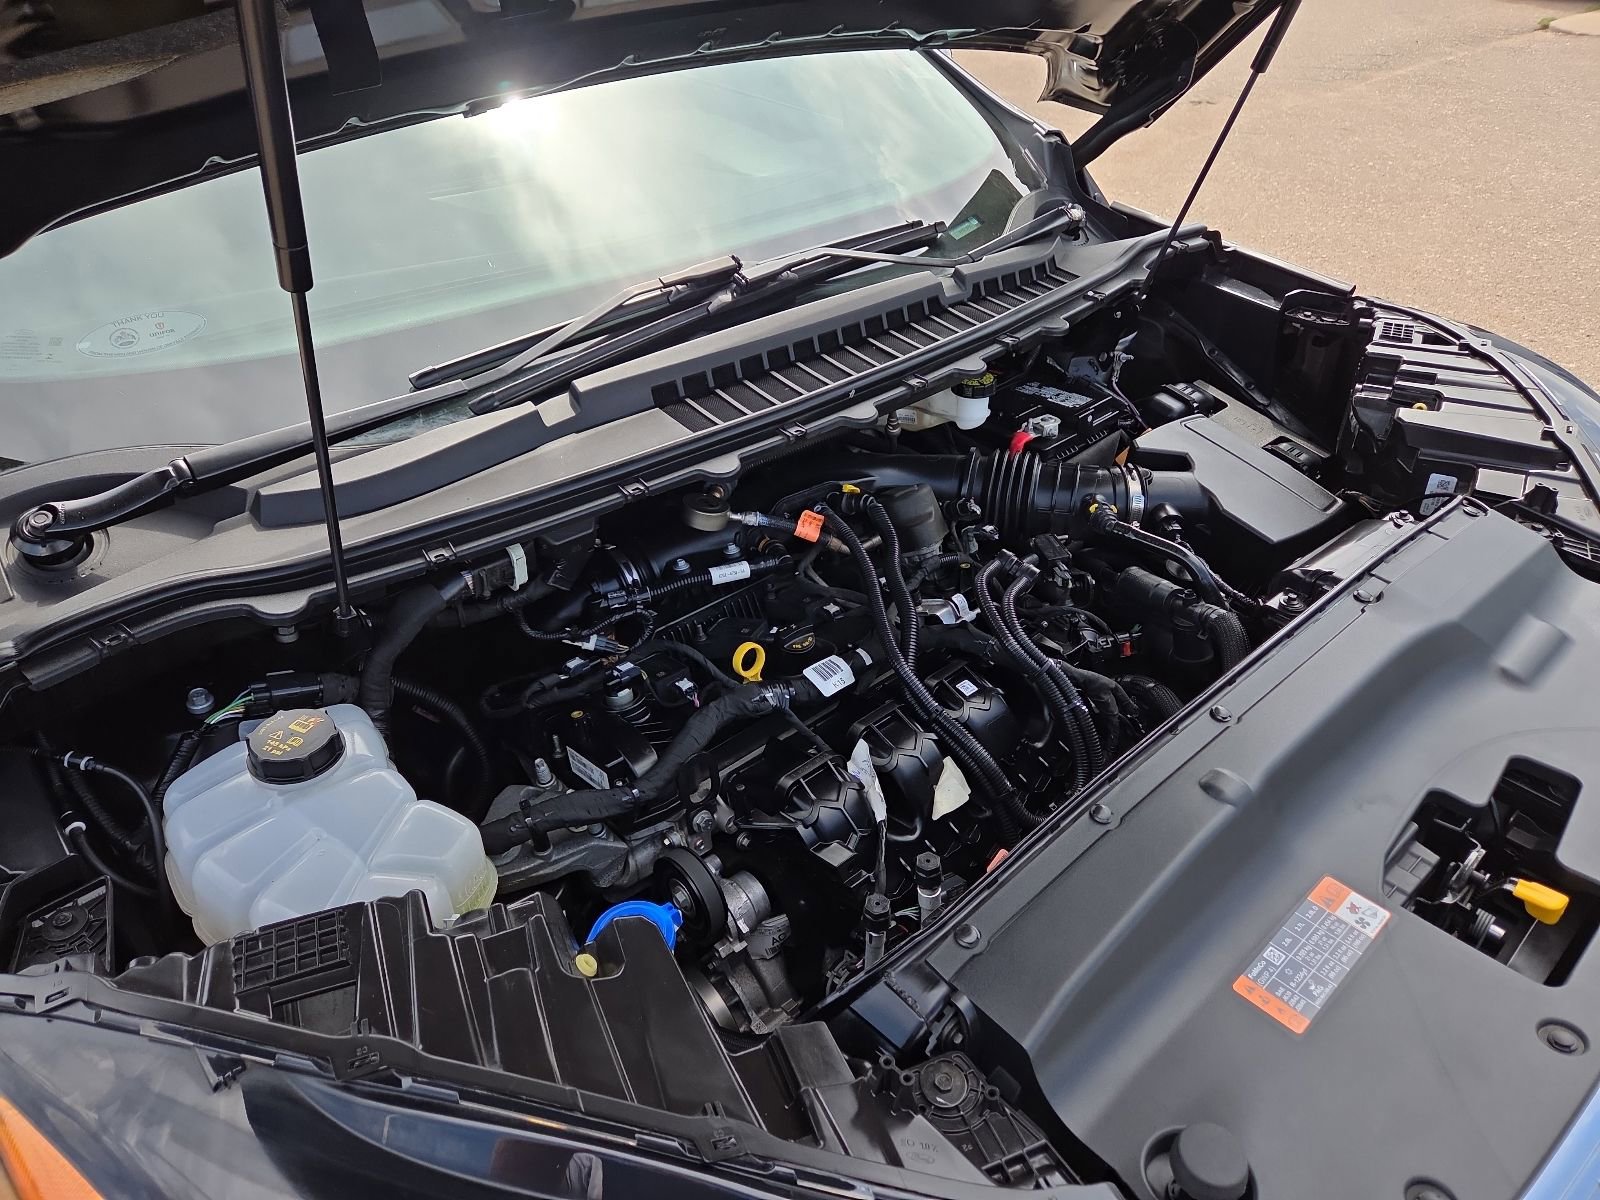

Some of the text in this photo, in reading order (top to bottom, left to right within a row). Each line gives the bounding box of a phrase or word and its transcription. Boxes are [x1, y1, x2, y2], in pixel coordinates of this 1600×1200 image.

[112, 311, 165, 329] THANK YOU
[1247, 959, 1267, 979] FoMoCo
[1255, 969, 1272, 986] (GWP
